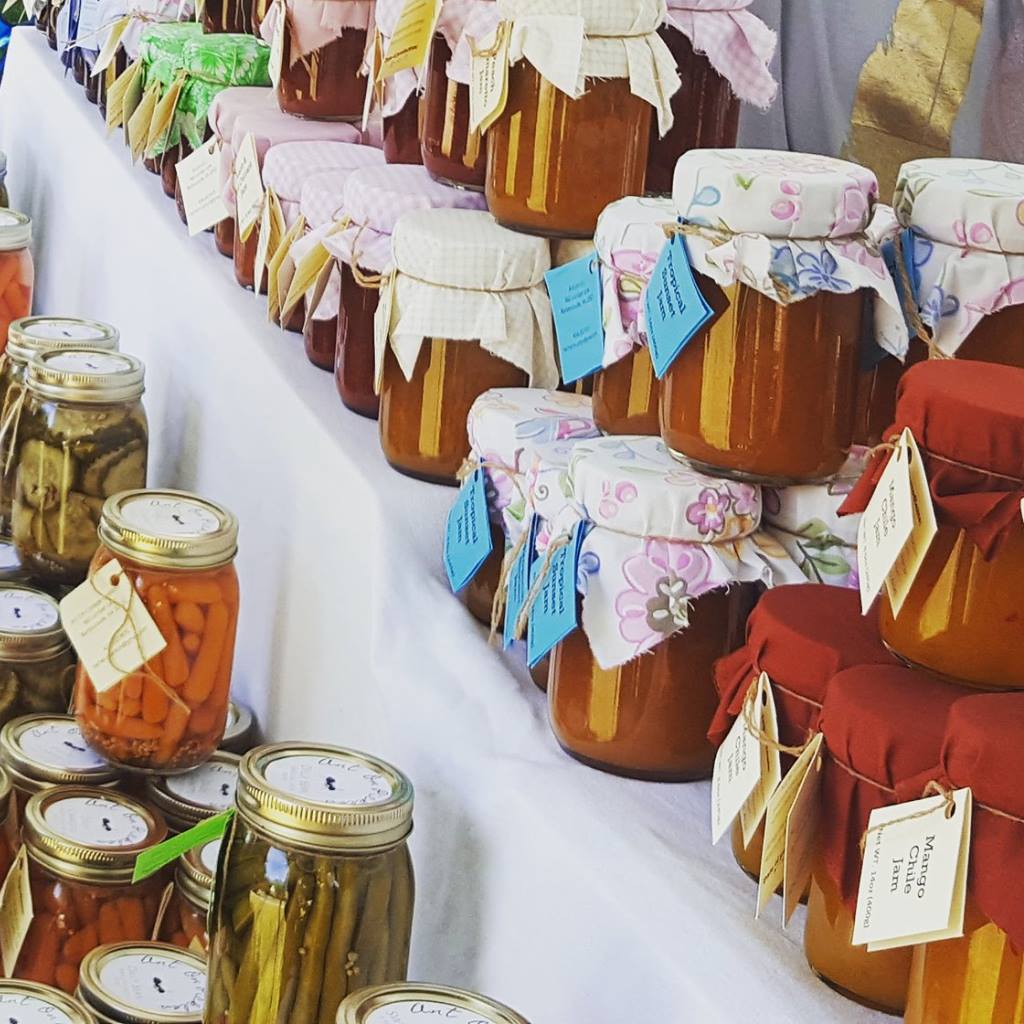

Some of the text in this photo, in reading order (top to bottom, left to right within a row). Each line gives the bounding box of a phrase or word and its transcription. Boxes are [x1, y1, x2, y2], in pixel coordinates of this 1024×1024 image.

[890, 858, 904, 893] Jam
[904, 845, 919, 895] Chile
[917, 835, 936, 899] Mango
